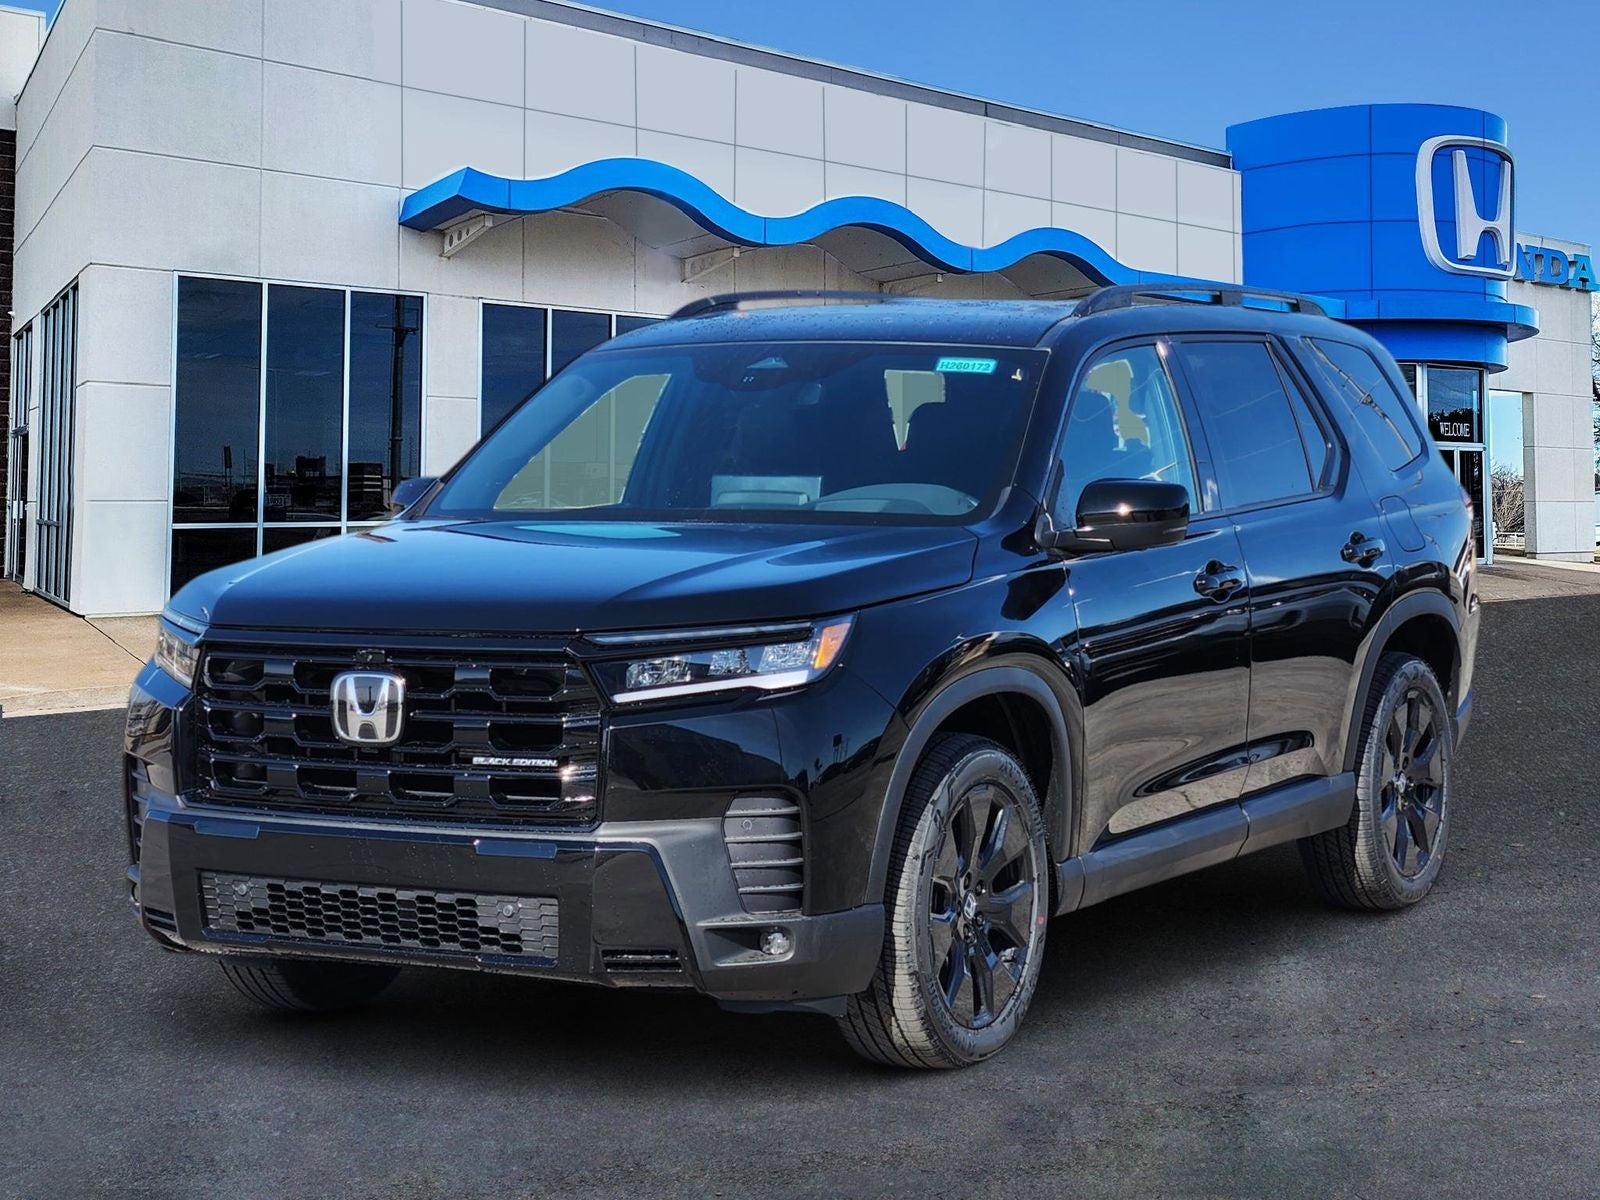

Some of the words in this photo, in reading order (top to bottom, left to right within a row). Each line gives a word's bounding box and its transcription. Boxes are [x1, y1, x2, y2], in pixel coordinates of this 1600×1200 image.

[1440, 421, 1471, 437] WELCOME
[472, 756, 512, 766] BLACK
[511, 758, 559, 768] EDITION
